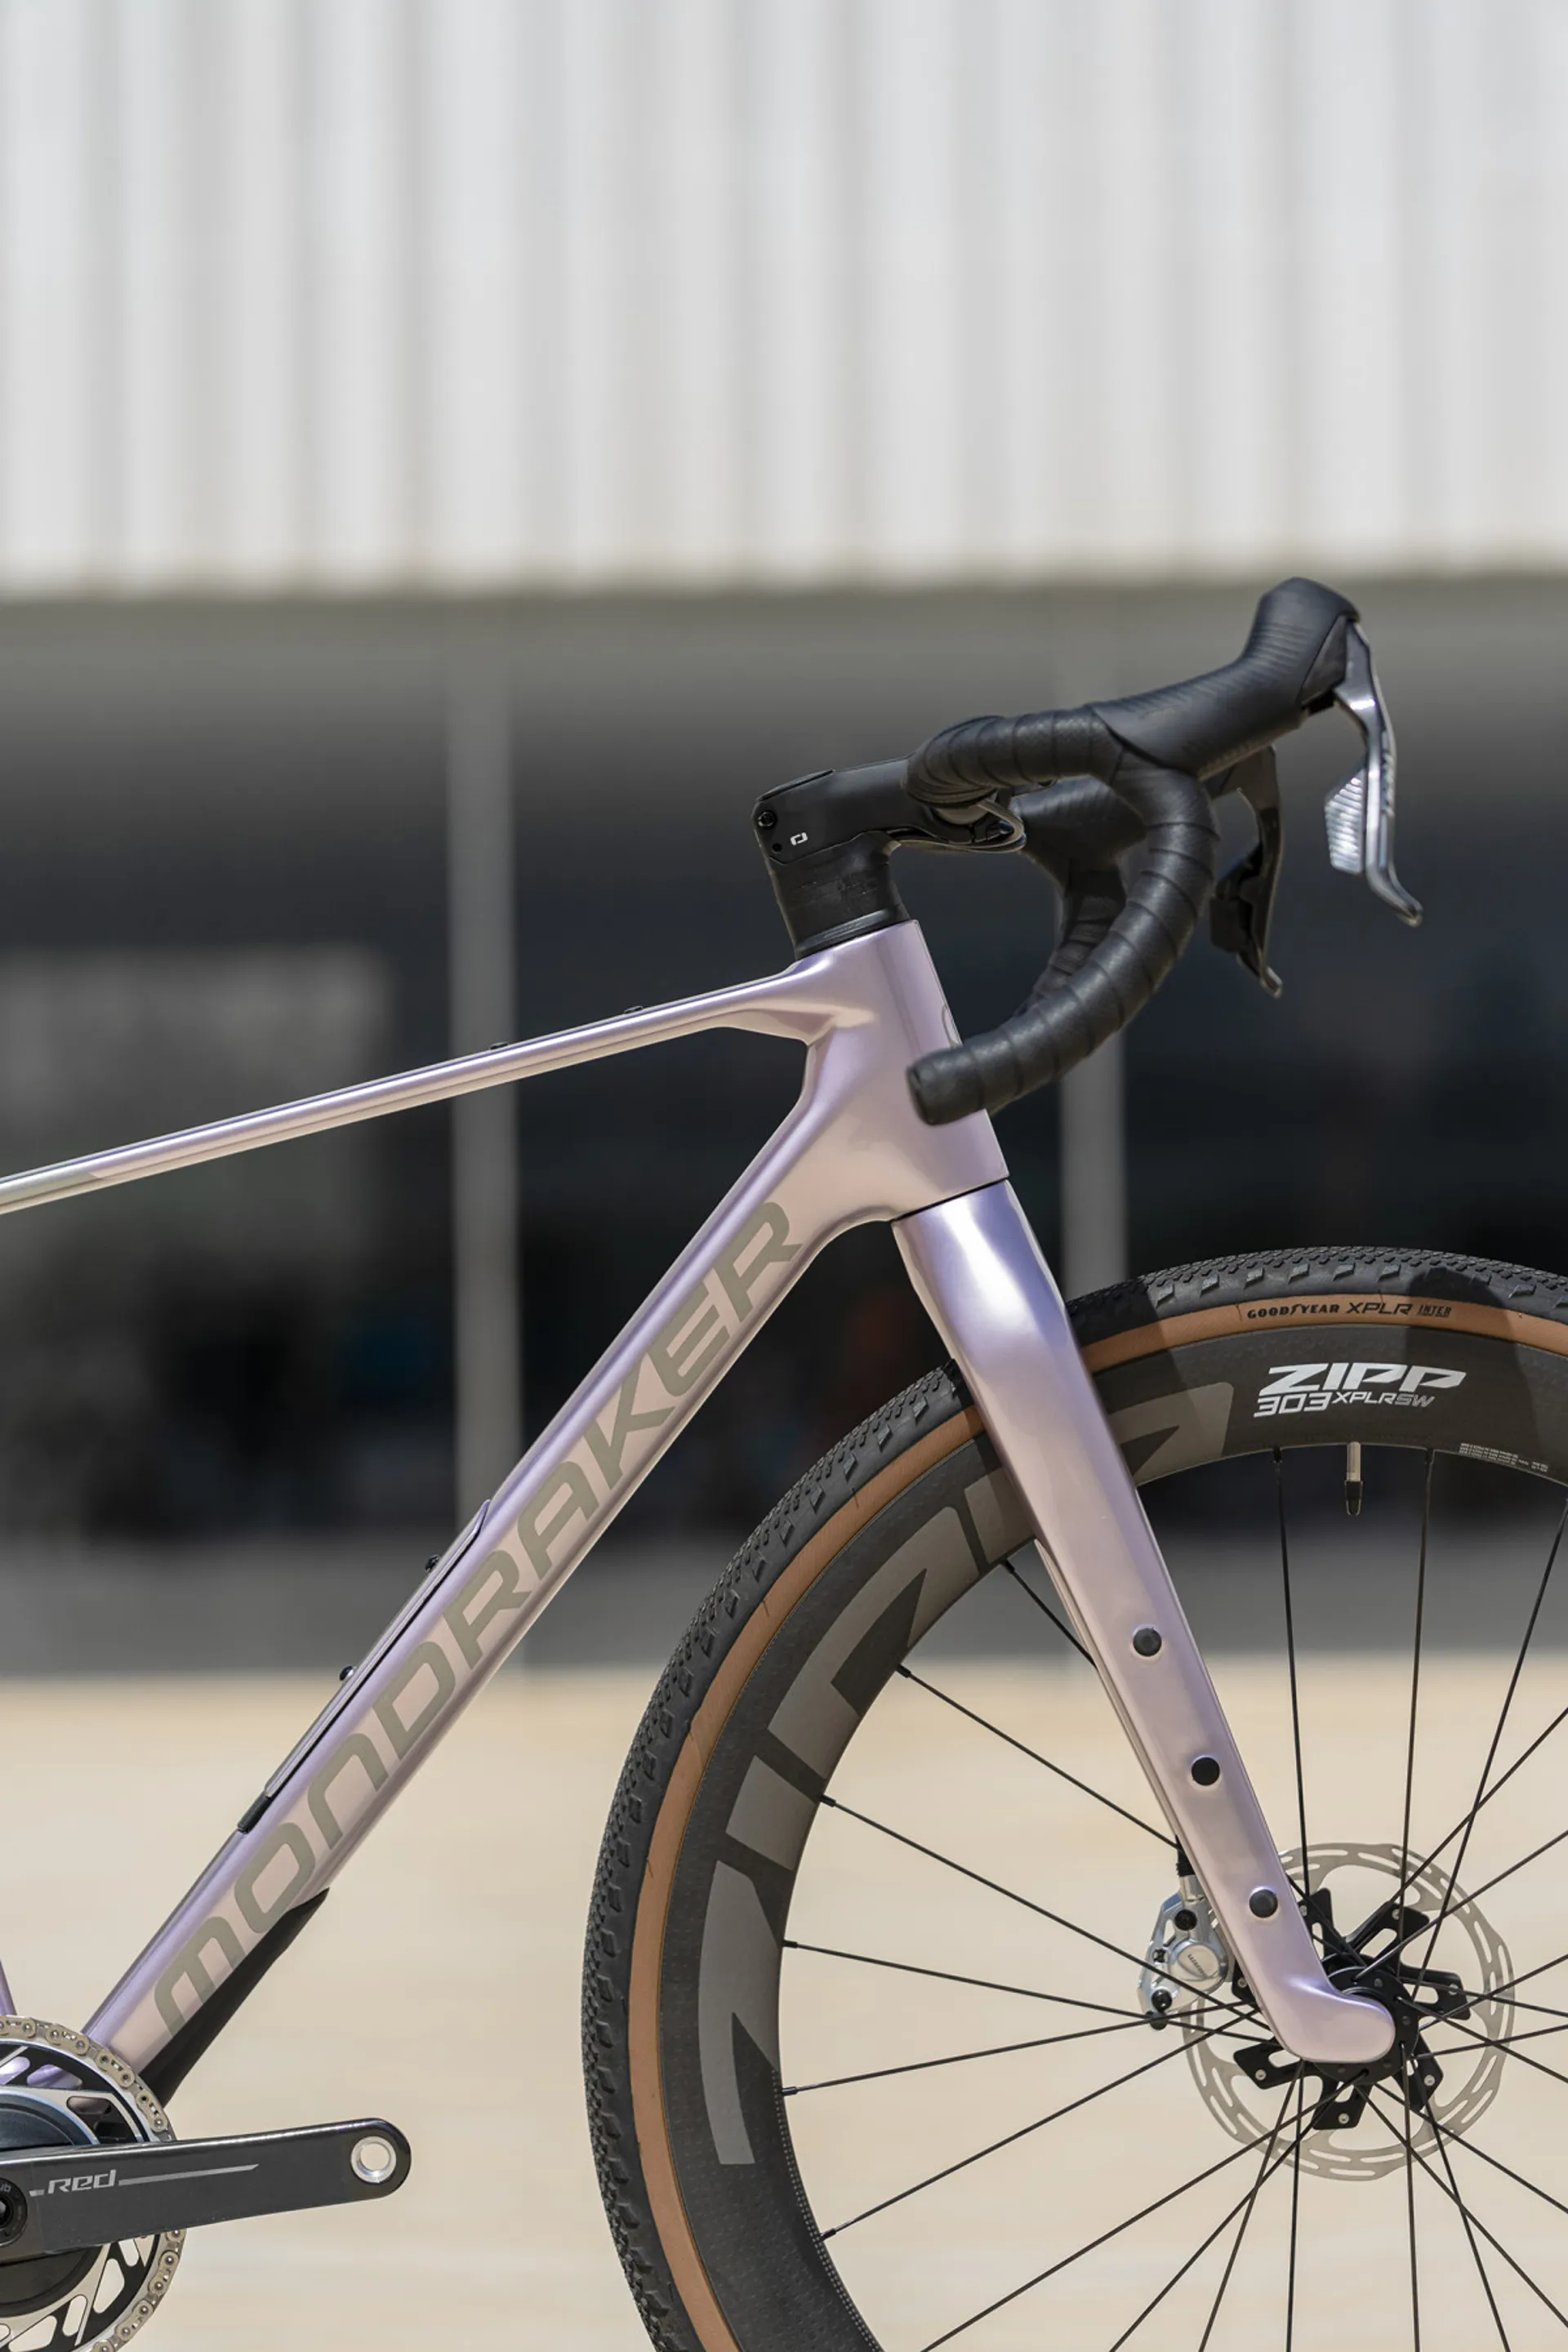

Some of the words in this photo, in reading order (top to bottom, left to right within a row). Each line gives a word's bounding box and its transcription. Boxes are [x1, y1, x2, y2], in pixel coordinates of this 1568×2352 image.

[1247, 1303, 1340, 1319] GOODYEAR
[1346, 1302, 1414, 1316] XPLR
[1258, 1362, 1467, 1396] ZIPP
[1254, 1392, 1332, 1418] 303
